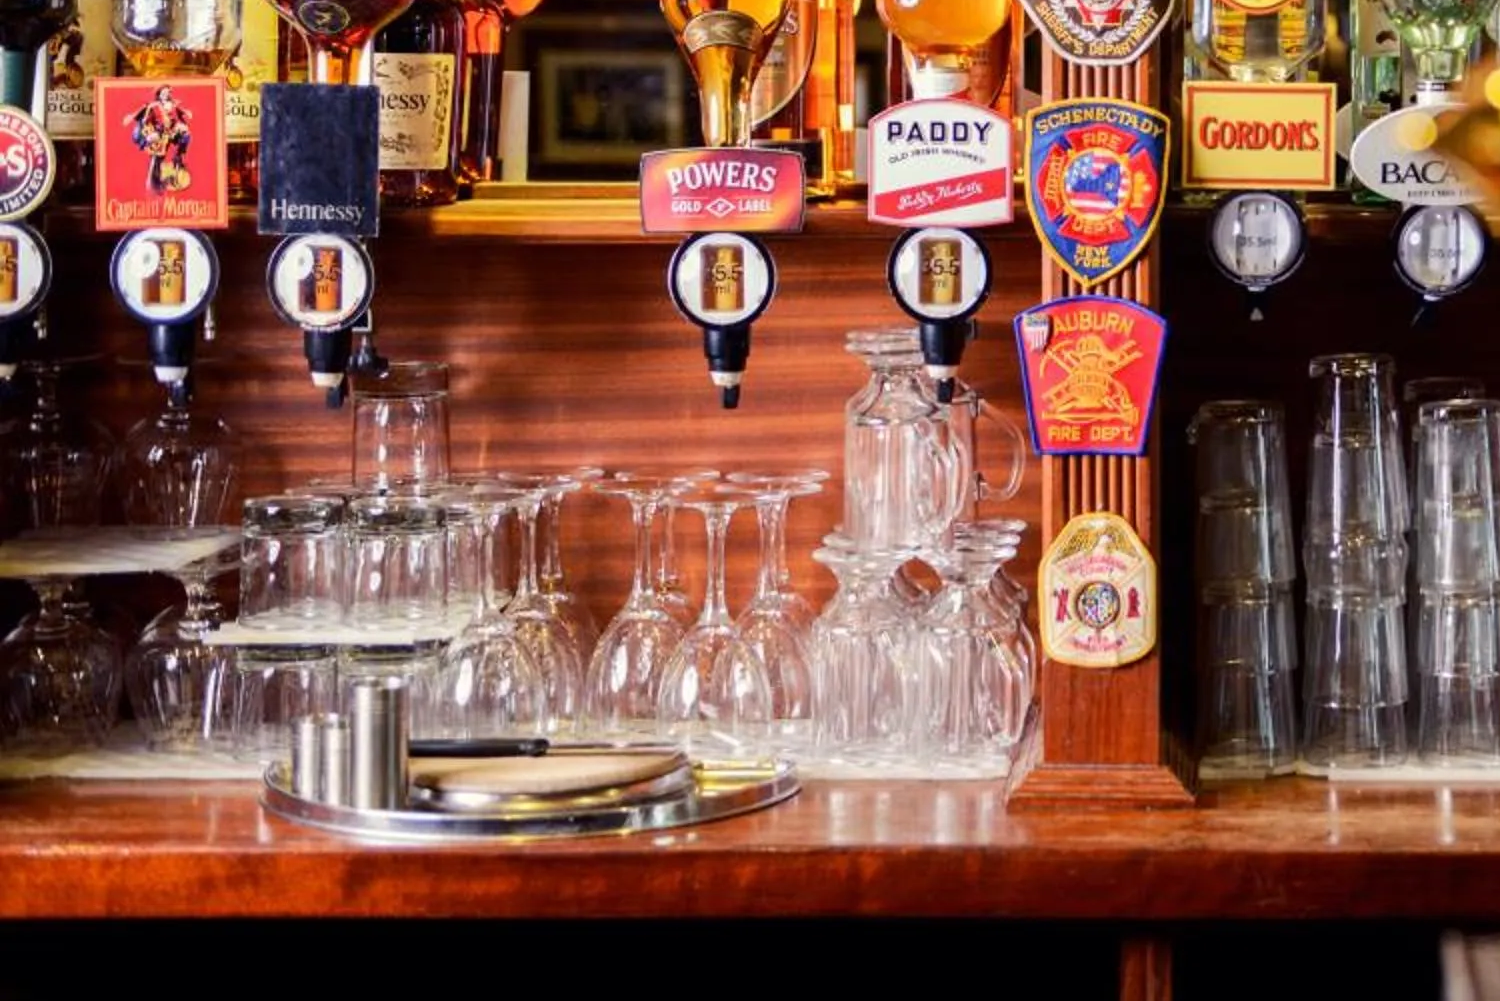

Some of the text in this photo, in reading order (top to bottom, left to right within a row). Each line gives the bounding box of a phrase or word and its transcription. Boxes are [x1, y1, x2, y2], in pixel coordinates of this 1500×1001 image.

[1089, 7, 1160, 56] DEPARTMENT
[887, 120, 993, 144] PADDY
[1036, 106, 1164, 138] SCHENECTADY
[1199, 116, 1321, 152] GORDON'S
[1082, 130, 1123, 149] FIRE
[888, 151, 909, 165] OLD
[911, 146, 938, 158] IRISH
[666, 160, 778, 195] POWERS
[1381, 160, 1461, 185] BACA
[106, 199, 160, 222] Captain
[271, 198, 366, 224] Hennessy
[671, 199, 702, 213] GOLD
[738, 199, 773, 213] LABEL
[1071, 215, 1118, 235] DEPT
[1053, 310, 1137, 338] AUBURN
[1048, 424, 1081, 443] FIRE
